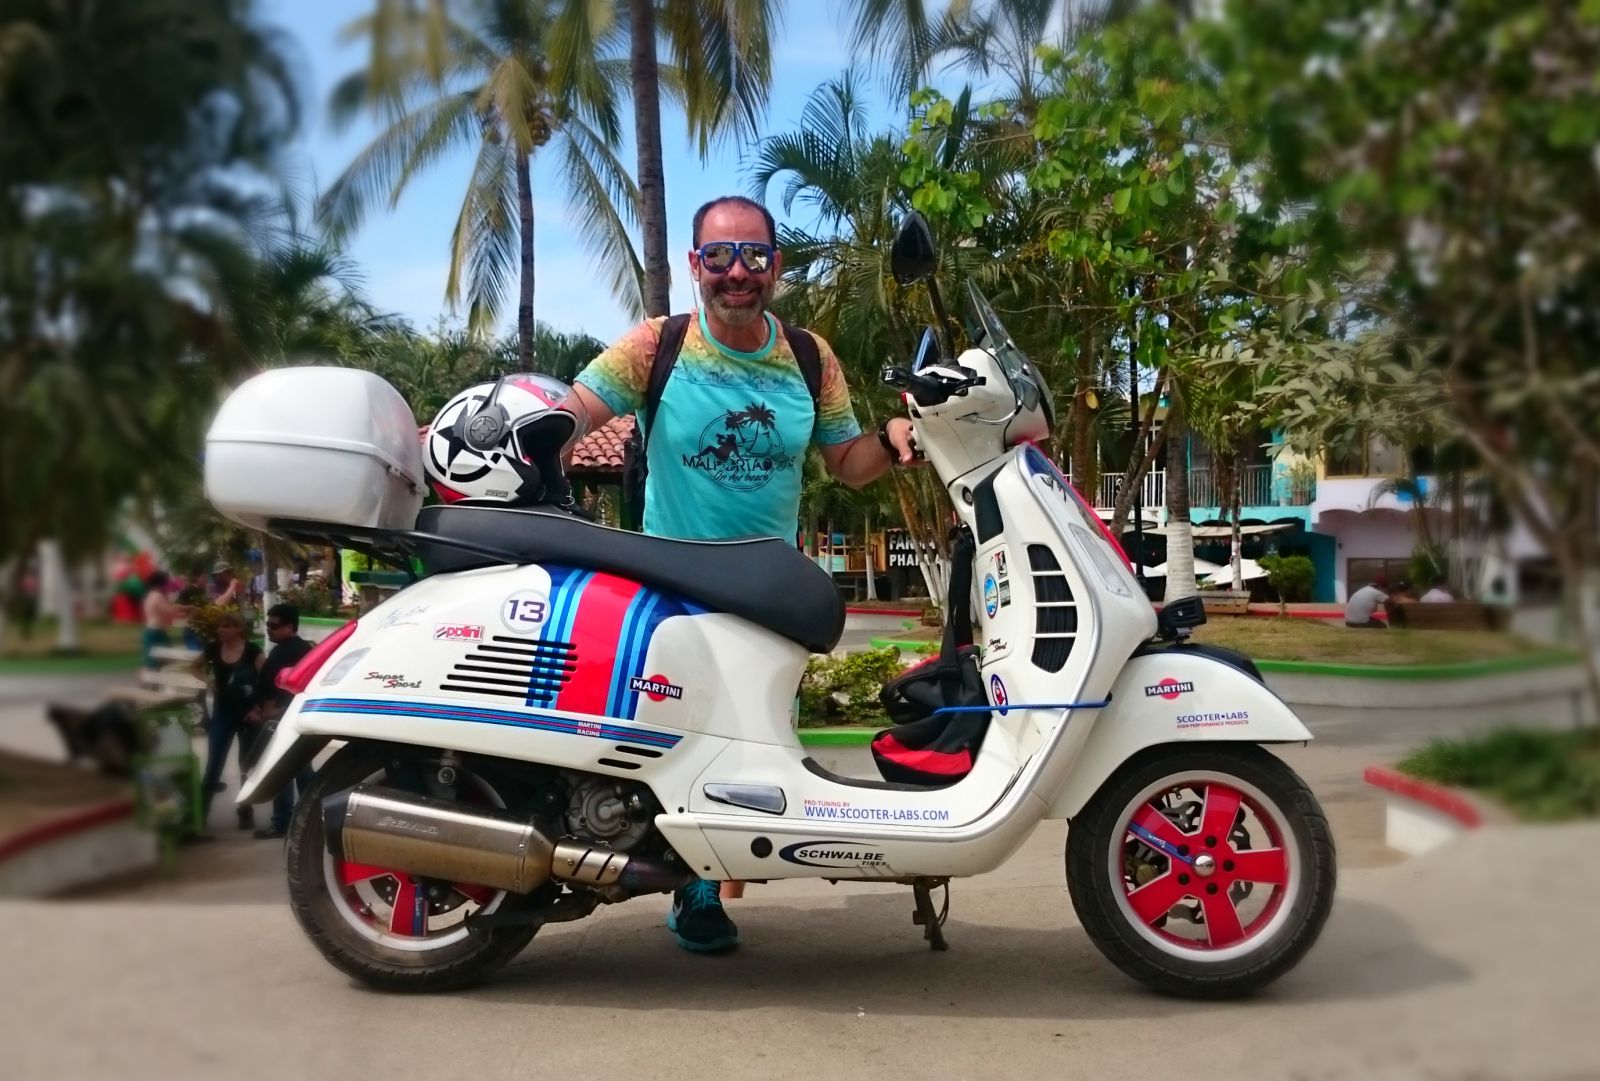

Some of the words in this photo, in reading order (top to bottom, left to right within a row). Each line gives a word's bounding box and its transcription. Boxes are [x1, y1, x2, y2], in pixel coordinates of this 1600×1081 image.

[509, 599, 546, 623] 13
[364, 671, 405, 681] Super
[383, 679, 422, 688] Sport
[632, 679, 681, 698] MARTINI
[1147, 683, 1191, 695] MARTINI
[577, 721, 602, 730] MARTINI
[576, 728, 601, 738] RACING
[804, 799, 842, 807] PRO-TUNING
[804, 806, 949, 821] WWW.SCOOTER-LABS.COM
[798, 850, 885, 860] SCHWALBE
